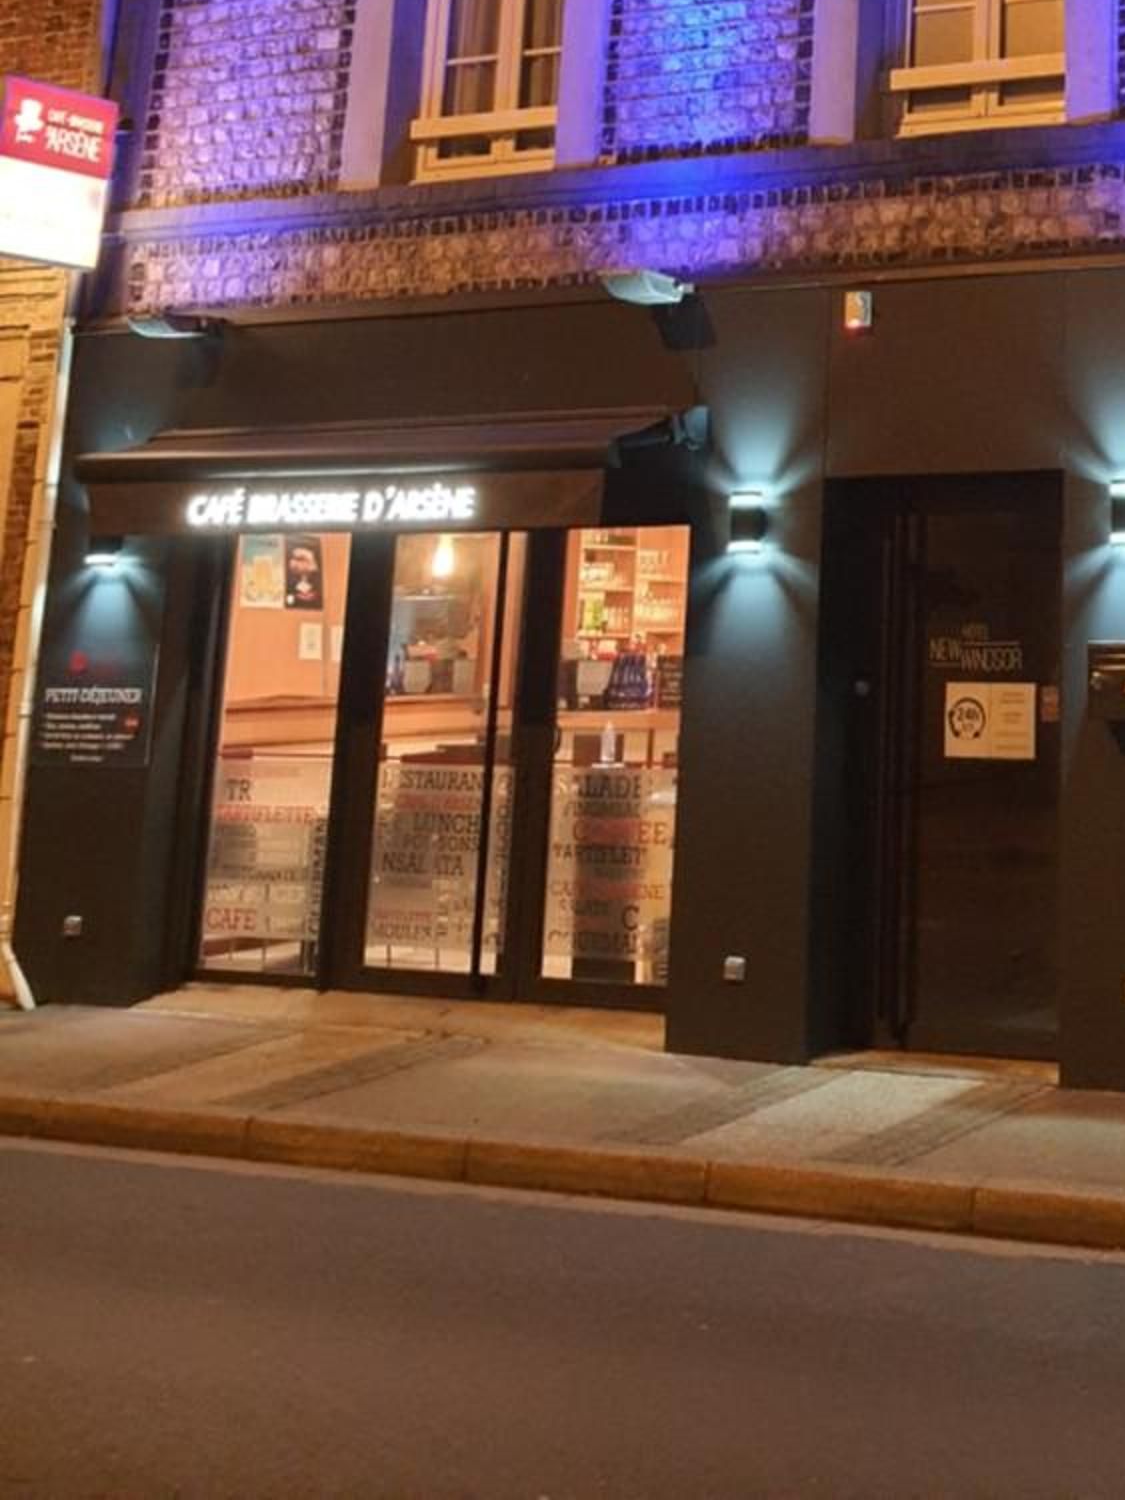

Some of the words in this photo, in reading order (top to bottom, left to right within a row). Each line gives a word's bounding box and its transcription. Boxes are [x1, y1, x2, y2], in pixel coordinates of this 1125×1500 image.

[185, 486, 246, 525] CAFÉ
[247, 491, 360, 523] BRASSERIE
[929, 636, 962, 661] NEW
[961, 647, 1023, 672] WINDSOR
